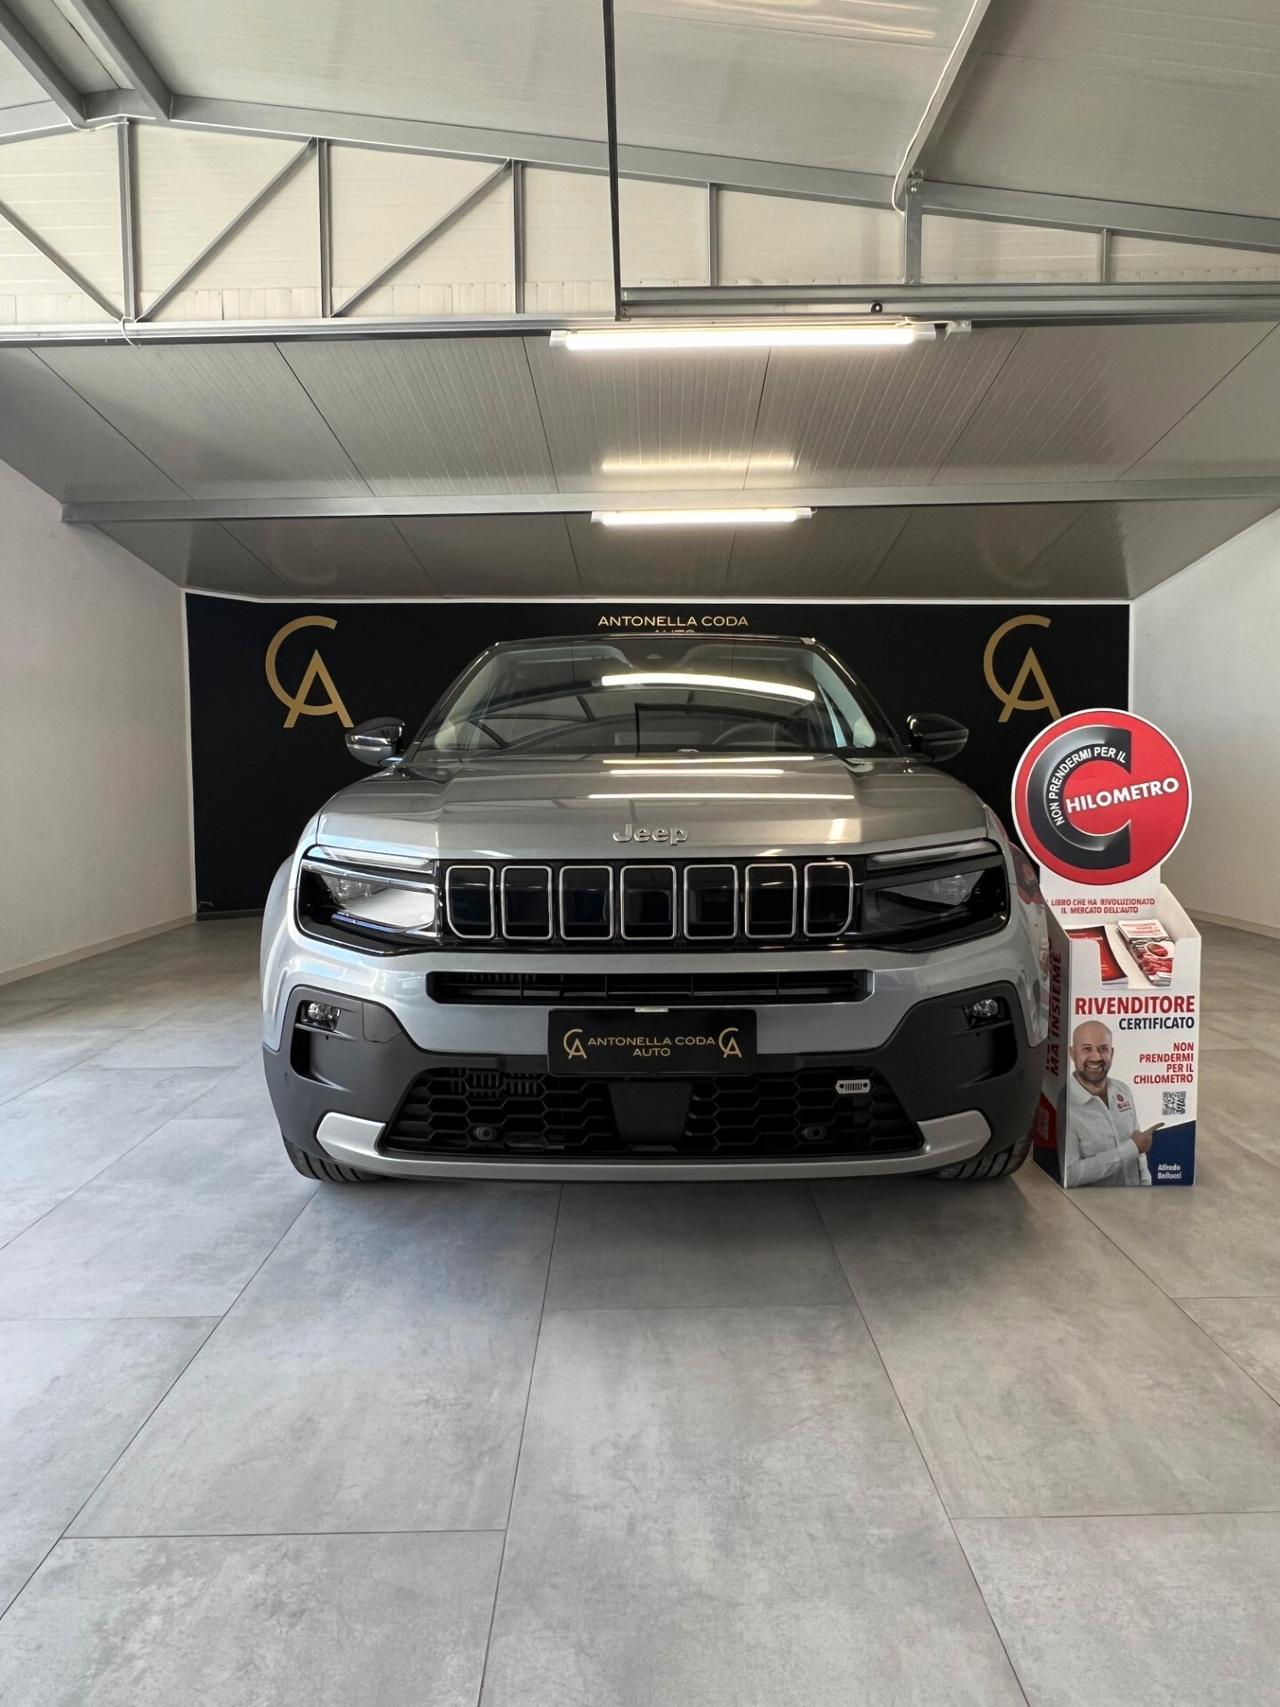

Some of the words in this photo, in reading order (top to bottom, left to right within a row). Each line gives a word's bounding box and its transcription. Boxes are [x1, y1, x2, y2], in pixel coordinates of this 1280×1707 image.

[598, 615, 698, 627] ANTONELLA
[701, 615, 749, 627] CODA
[1094, 746, 1117, 759] PER
[1117, 750, 1127, 764] IL
[1049, 748, 1092, 800] PRENDERMI
[1049, 802, 1065, 827] NON
[613, 823, 688, 846] Jeep
[1051, 898, 1071, 906] LIBRO
[1073, 898, 1087, 906] CHE
[1088, 898, 1098, 906] HA
[1051, 952, 1061, 1039] INSIEME
[1075, 995, 1195, 1015] RIVENDITORE
[1119, 1017, 1195, 1030] CERTIFICATO
[588, 1037, 672, 1046] ANTONELLA
[674, 1036, 716, 1046] CODA
[1173, 1042, 1194, 1052] NON
[632, 1048, 671, 1057] AUTO
[1139, 1053, 1194, 1063] PRENDERMI
[1050, 1043, 1060, 1077] MA
[1166, 1064, 1184, 1073] PER
[1185, 1063, 1194, 1073] IL
[1133, 1074, 1193, 1084] CHILOMETRO
